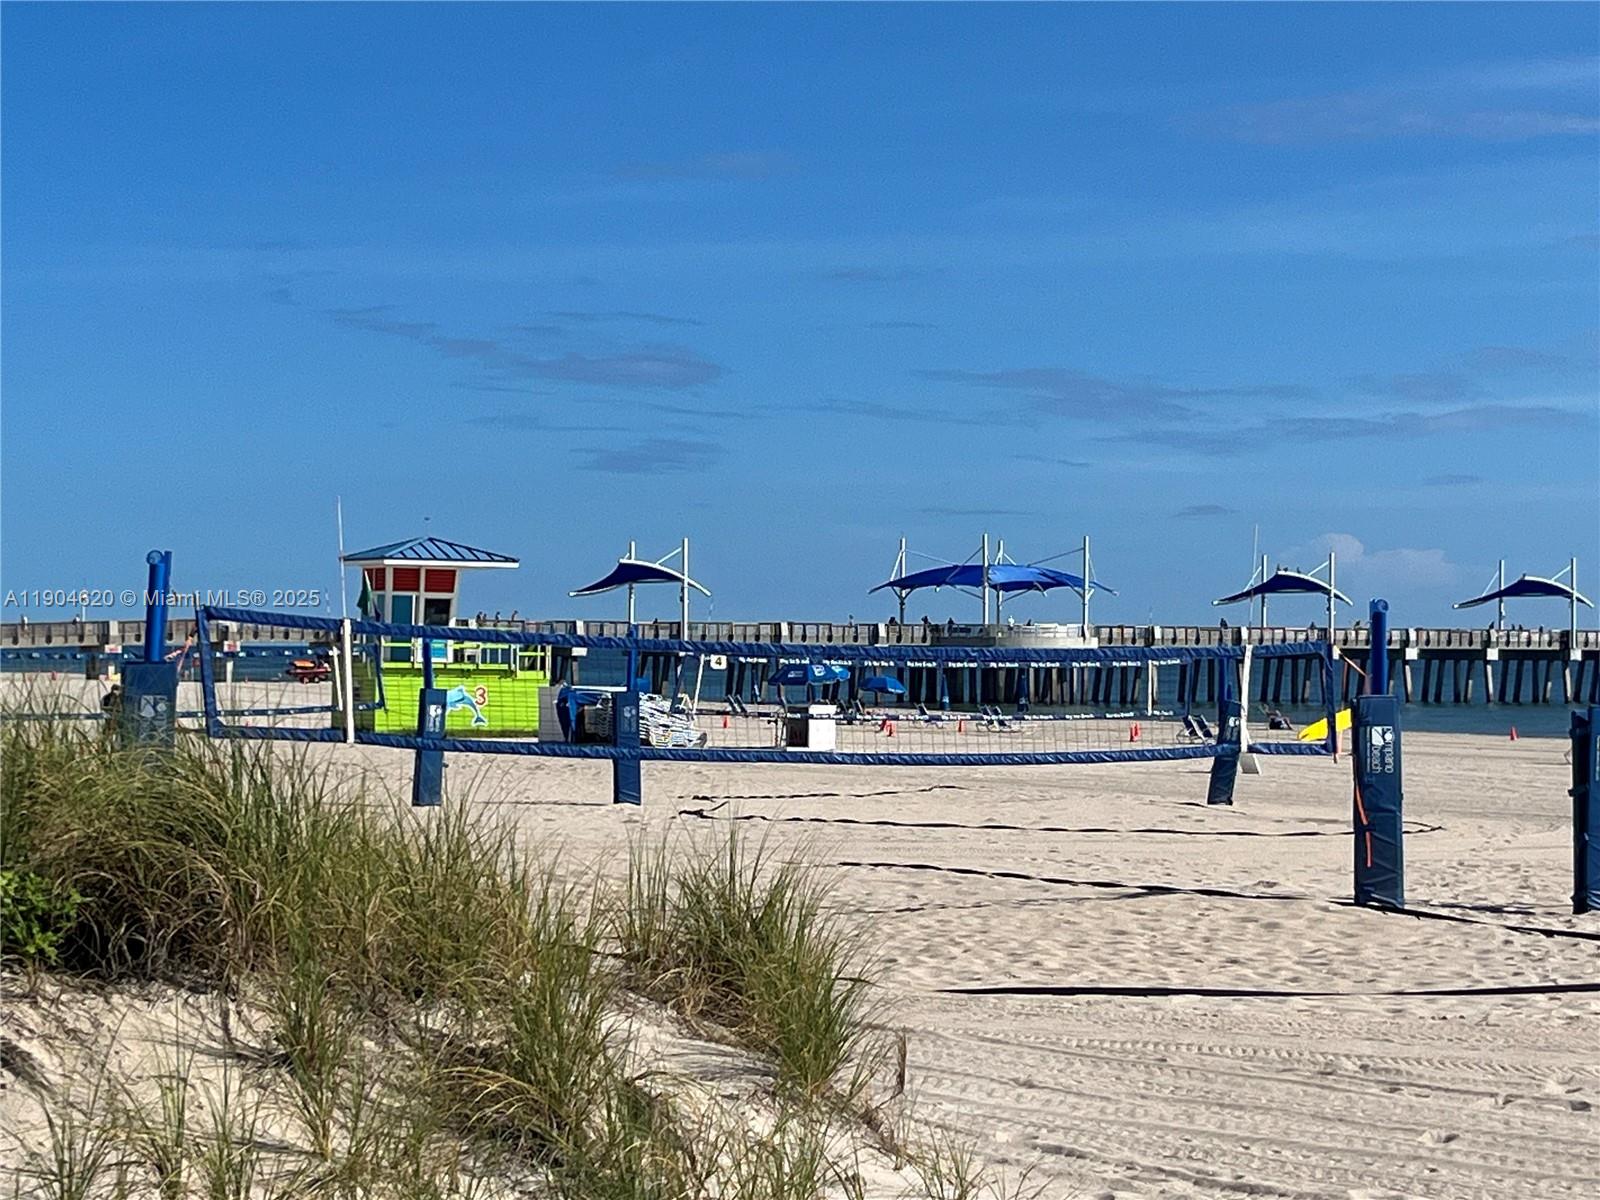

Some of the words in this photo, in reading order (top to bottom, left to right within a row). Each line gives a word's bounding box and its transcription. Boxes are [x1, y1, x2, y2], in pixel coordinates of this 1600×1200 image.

[714, 656, 722, 666] 4
[474, 687, 487, 705] 3
[1371, 745, 1382, 774] beach
